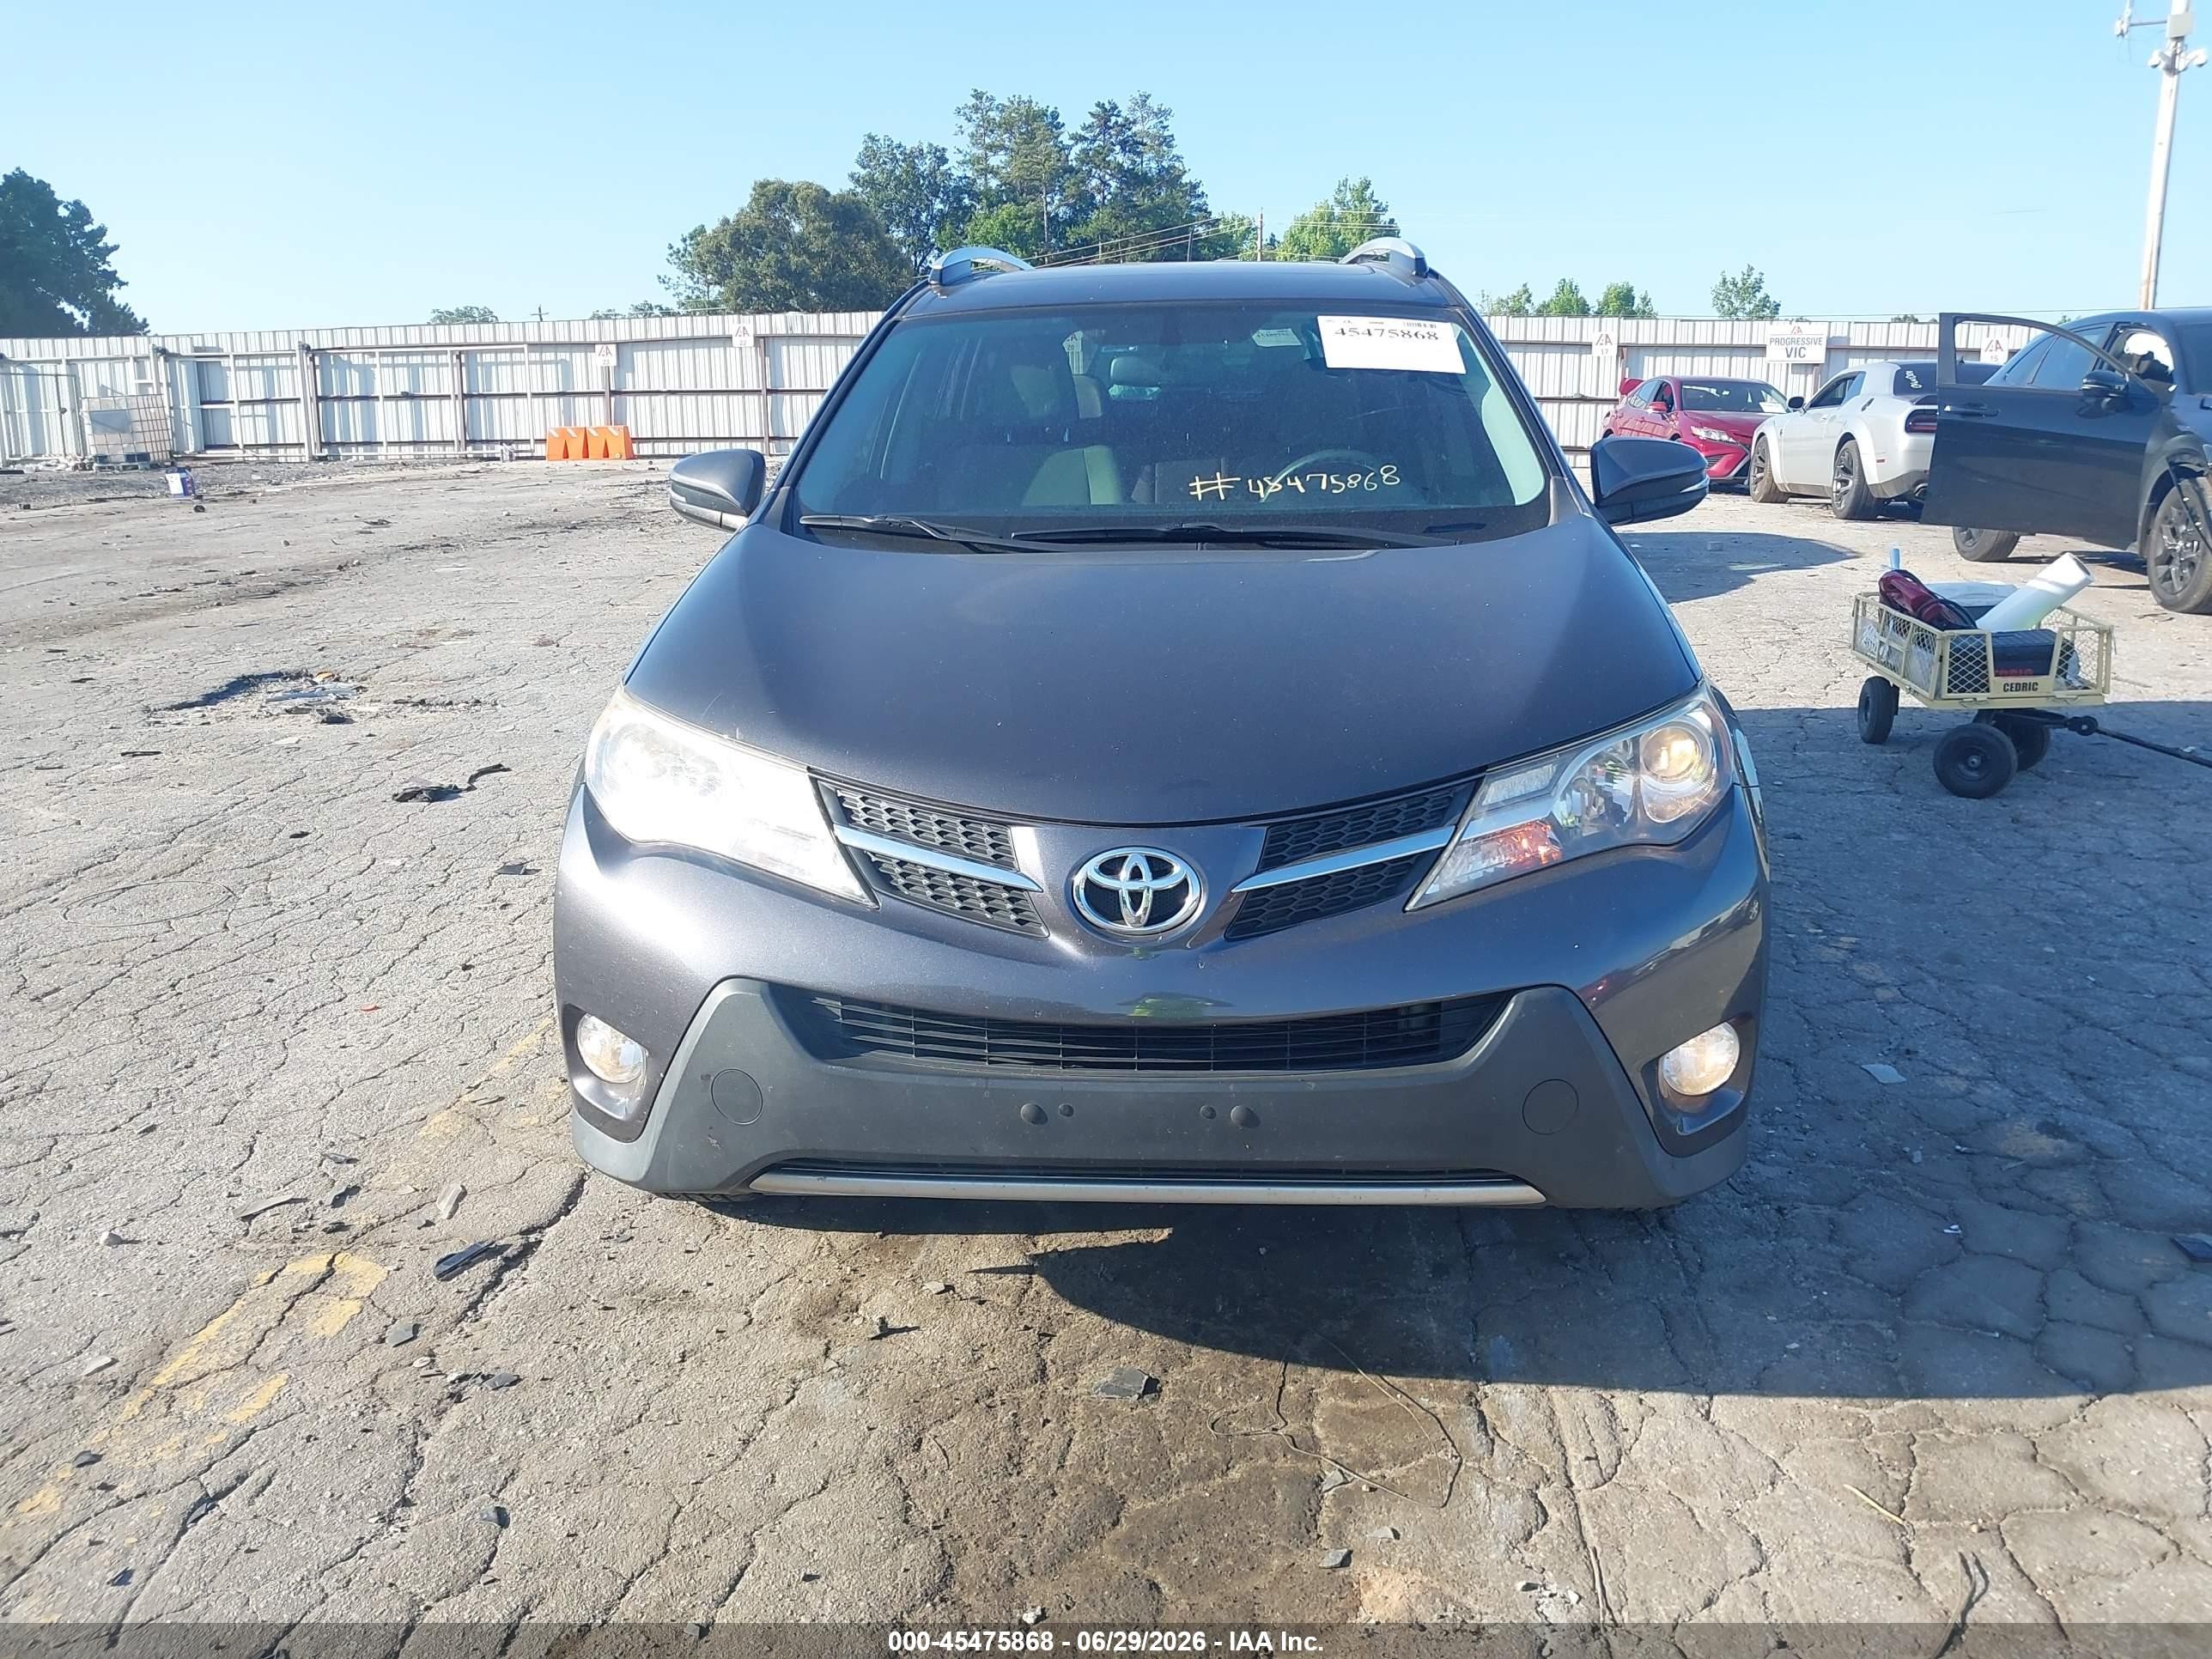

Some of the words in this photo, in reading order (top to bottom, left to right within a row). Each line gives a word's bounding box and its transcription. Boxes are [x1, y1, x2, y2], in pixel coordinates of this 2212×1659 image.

[1334, 327, 1439, 341] 45475868
[1769, 337, 1823, 346] PROGRESSIVE
[1785, 347, 1807, 358] VIC
[2002, 681, 2039, 692] CEDRIC
